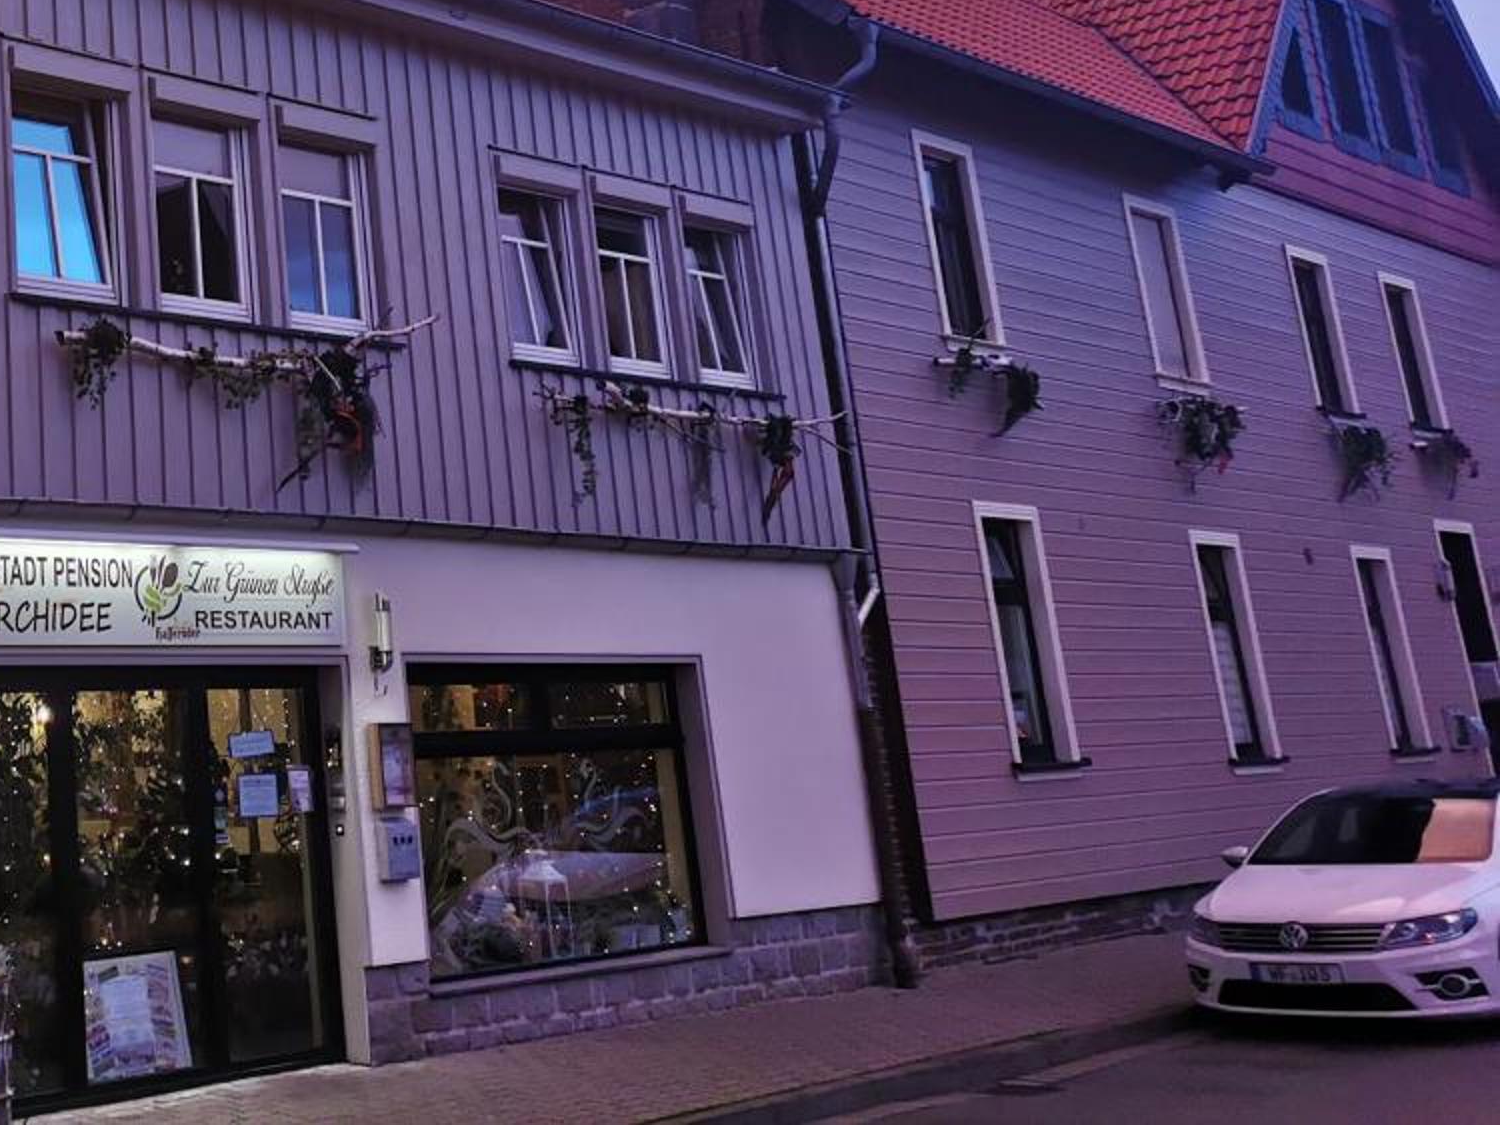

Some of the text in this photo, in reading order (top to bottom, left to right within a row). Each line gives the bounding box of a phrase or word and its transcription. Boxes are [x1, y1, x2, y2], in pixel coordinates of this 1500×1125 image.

[54, 557, 133, 588] PENSION
[185, 560, 221, 594] Zur
[224, 561, 279, 603] Grünen
[195, 610, 333, 630] RESTAURANT
